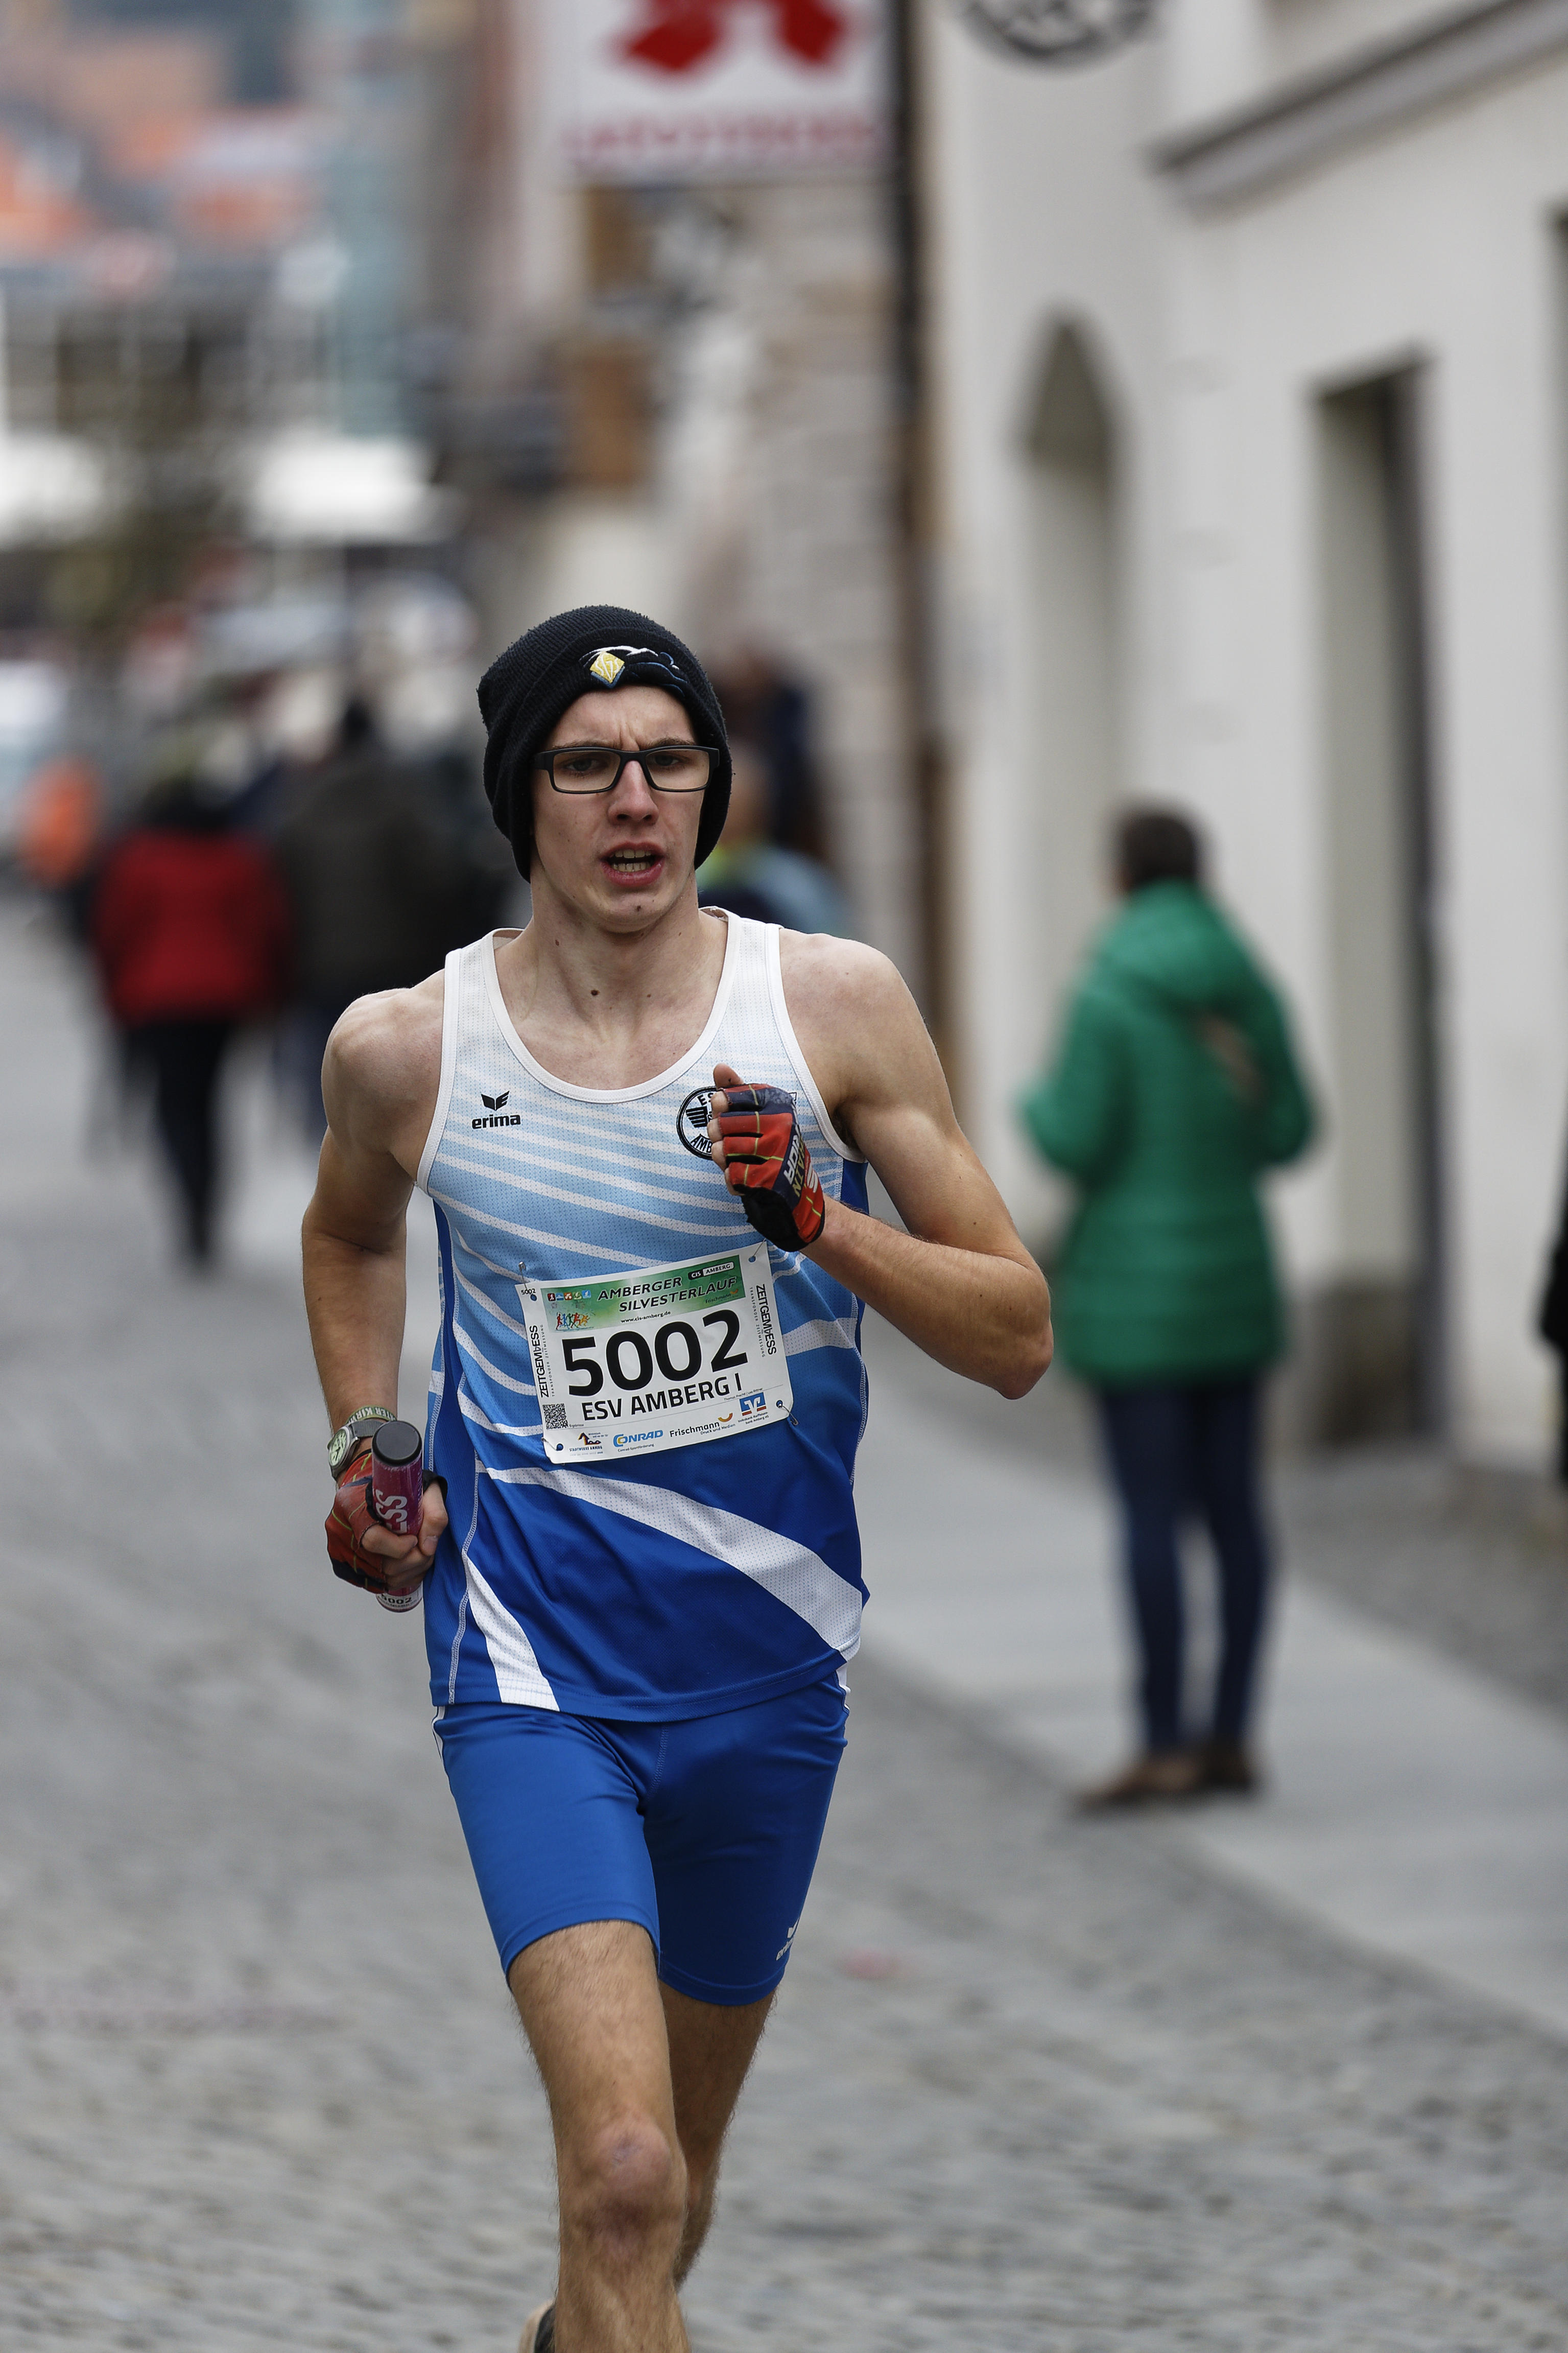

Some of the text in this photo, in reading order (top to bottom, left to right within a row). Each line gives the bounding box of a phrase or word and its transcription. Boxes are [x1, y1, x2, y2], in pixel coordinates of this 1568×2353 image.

[472, 1114, 521, 1130] erima
[691, 1137, 712, 1153] AMB
[706, 1264, 730, 1274] AMBERG
[598, 1277, 682, 1301] AMBERGER
[619, 1277, 737, 1312] SILVESTERLAUF
[621, 1311, 671, 1323] www.cis-amberg.de
[750, 1287, 765, 1357] TRANSPONDER ZEITMESSUNG
[540, 1325, 555, 1397] TRANSPONDER ZEITMESSUNG
[562, 1309, 748, 1397] 5002
[582, 1373, 742, 1421] ESV AMBERG I
[613, 1430, 663, 1447] CONRAD
[670, 1422, 720, 1437] Frischmann
